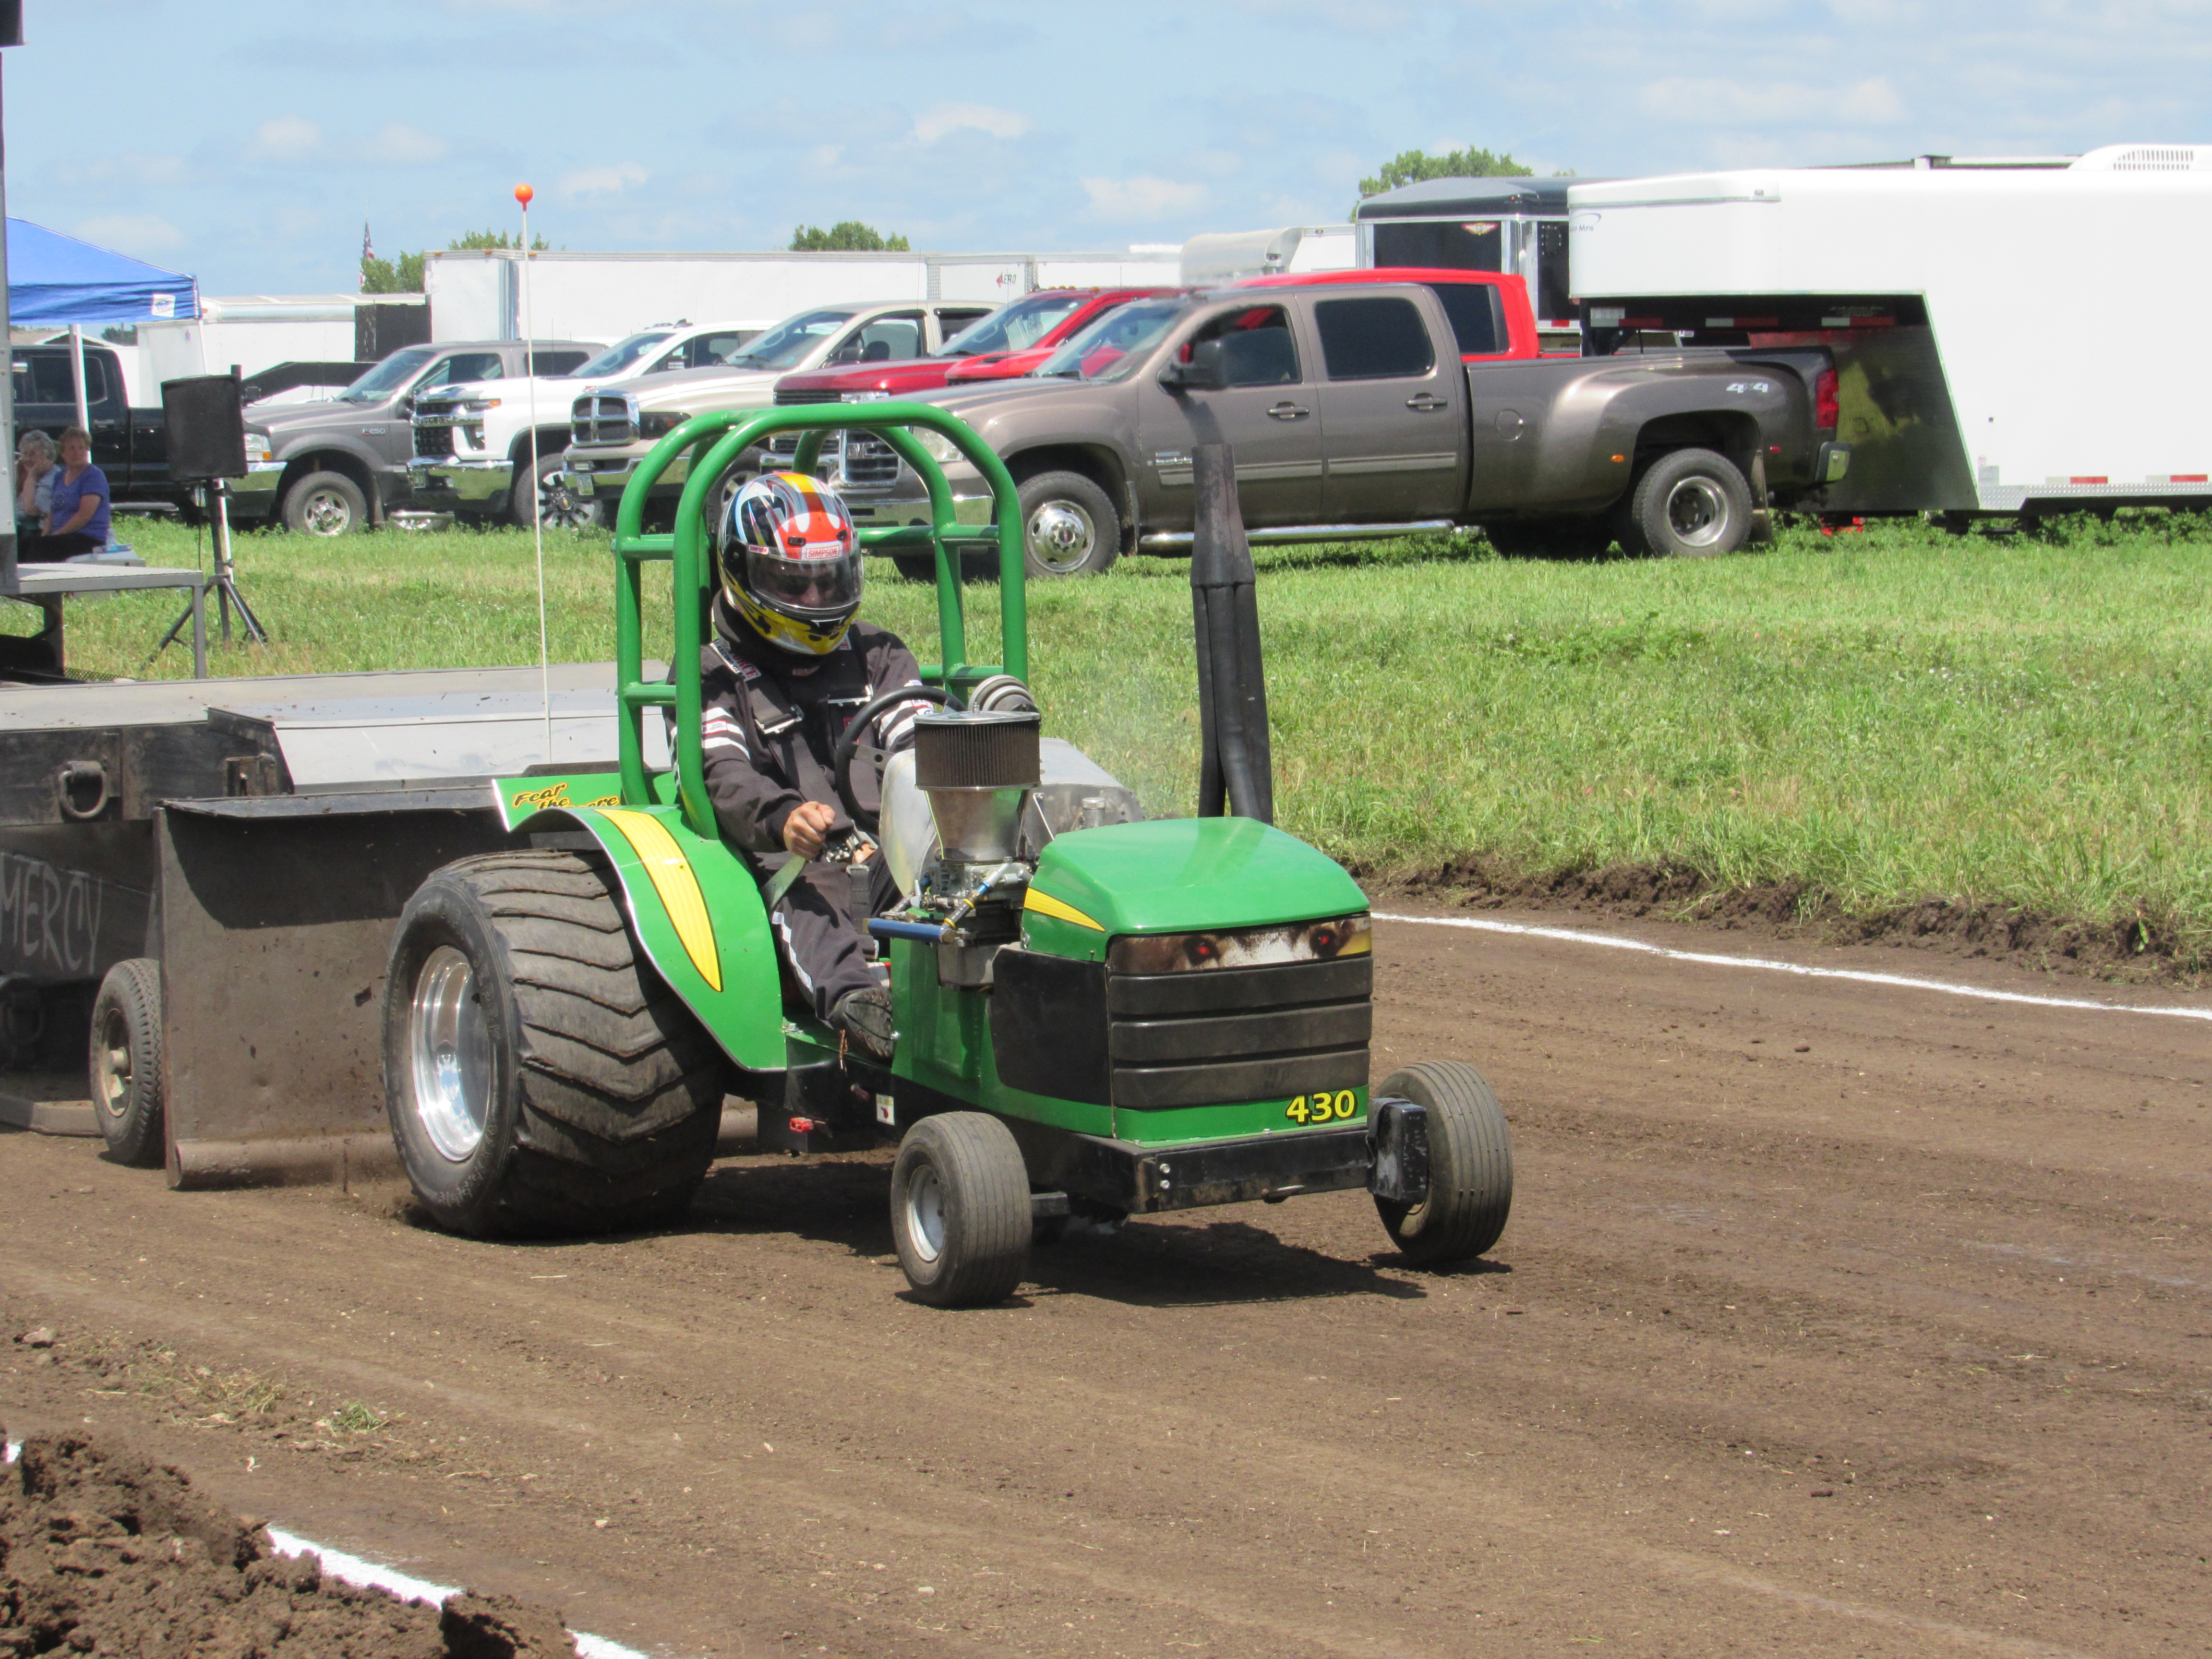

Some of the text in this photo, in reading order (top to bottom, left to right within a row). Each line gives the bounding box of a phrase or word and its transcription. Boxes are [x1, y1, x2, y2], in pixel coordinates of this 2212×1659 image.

[847, 442, 876, 459] GMC
[808, 547, 838, 558] SIMPSON
[513, 783, 567, 807] Fear
[537, 797, 570, 810] the
[0, 854, 102, 975] MERCY
[1286, 1090, 1357, 1124] 430
